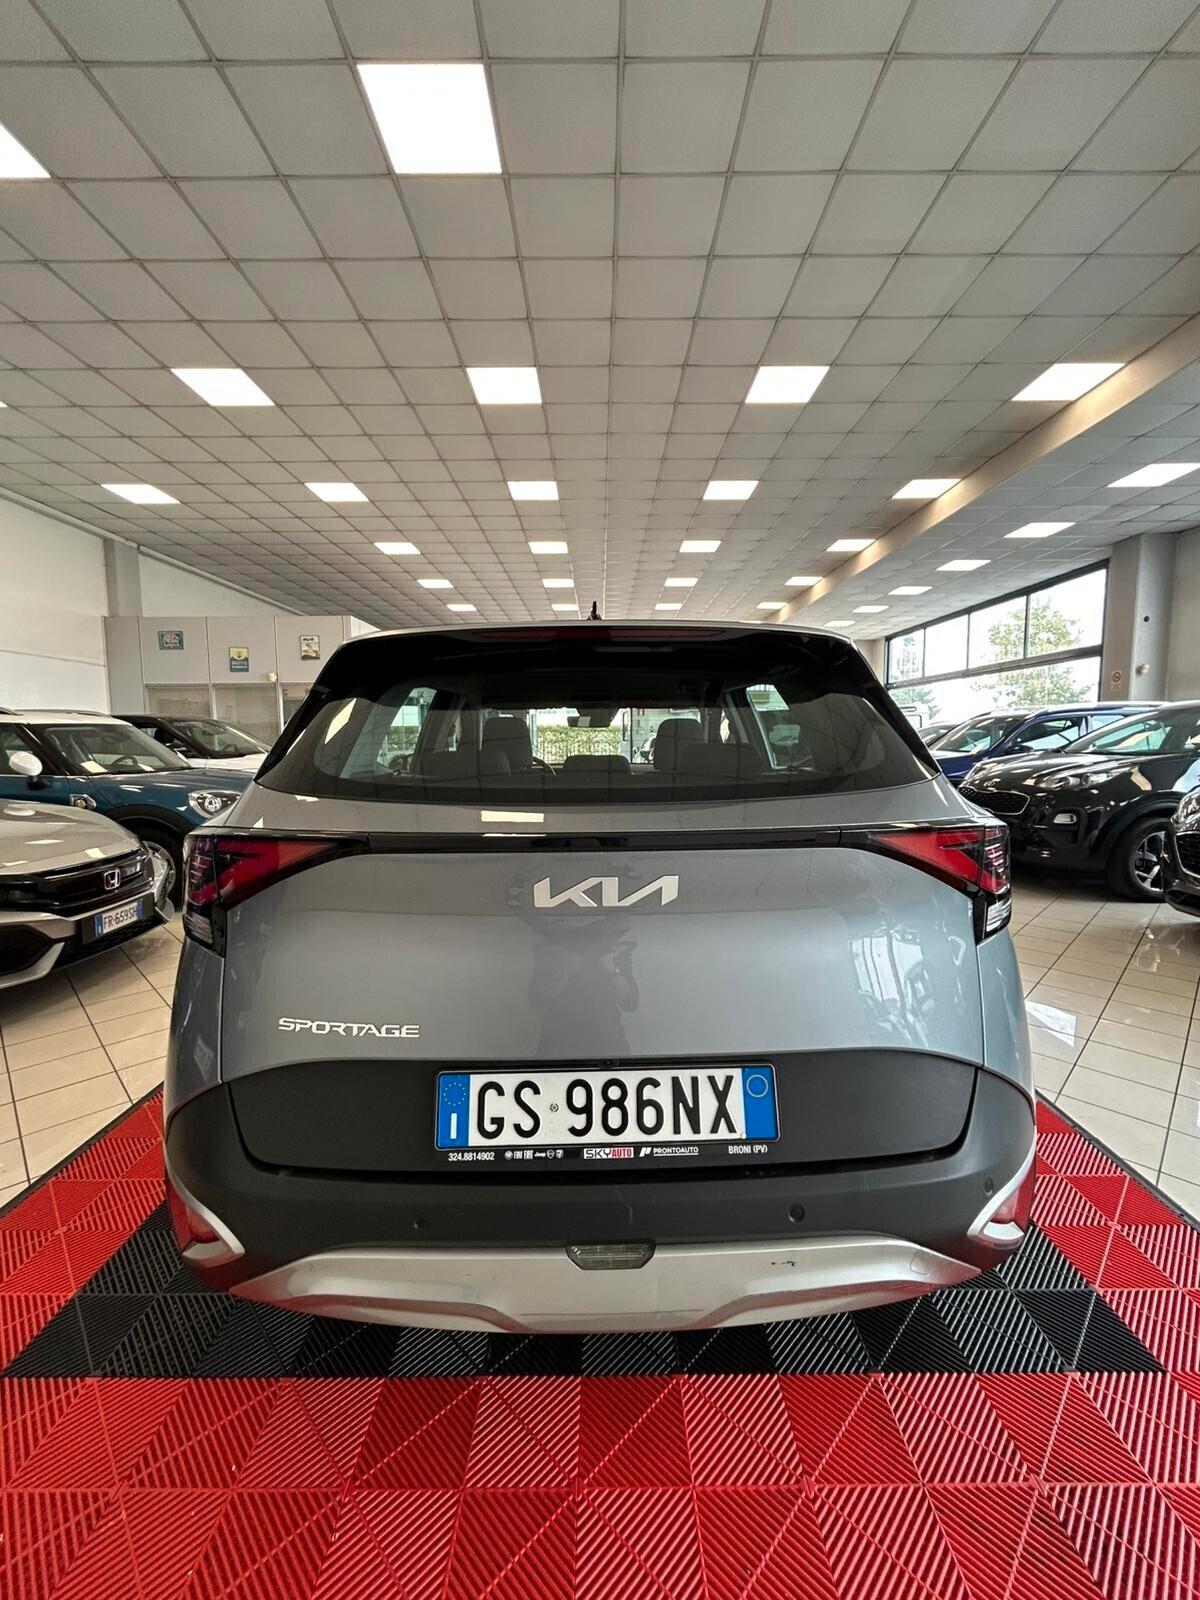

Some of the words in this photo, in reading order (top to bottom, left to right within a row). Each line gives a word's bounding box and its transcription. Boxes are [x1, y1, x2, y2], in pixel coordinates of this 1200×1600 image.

[533, 875, 680, 908] KIA
[278, 1017, 421, 1039] SPORTAGE
[477, 1078, 541, 1139] GS
[566, 1075, 738, 1137] 986NX
[448, 1151, 495, 1162] 324.8814902
[653, 1146, 699, 1155] PRONTOAUTO
[728, 1145, 752, 1155] BRONI
[752, 1144, 768, 1154] (PV)
